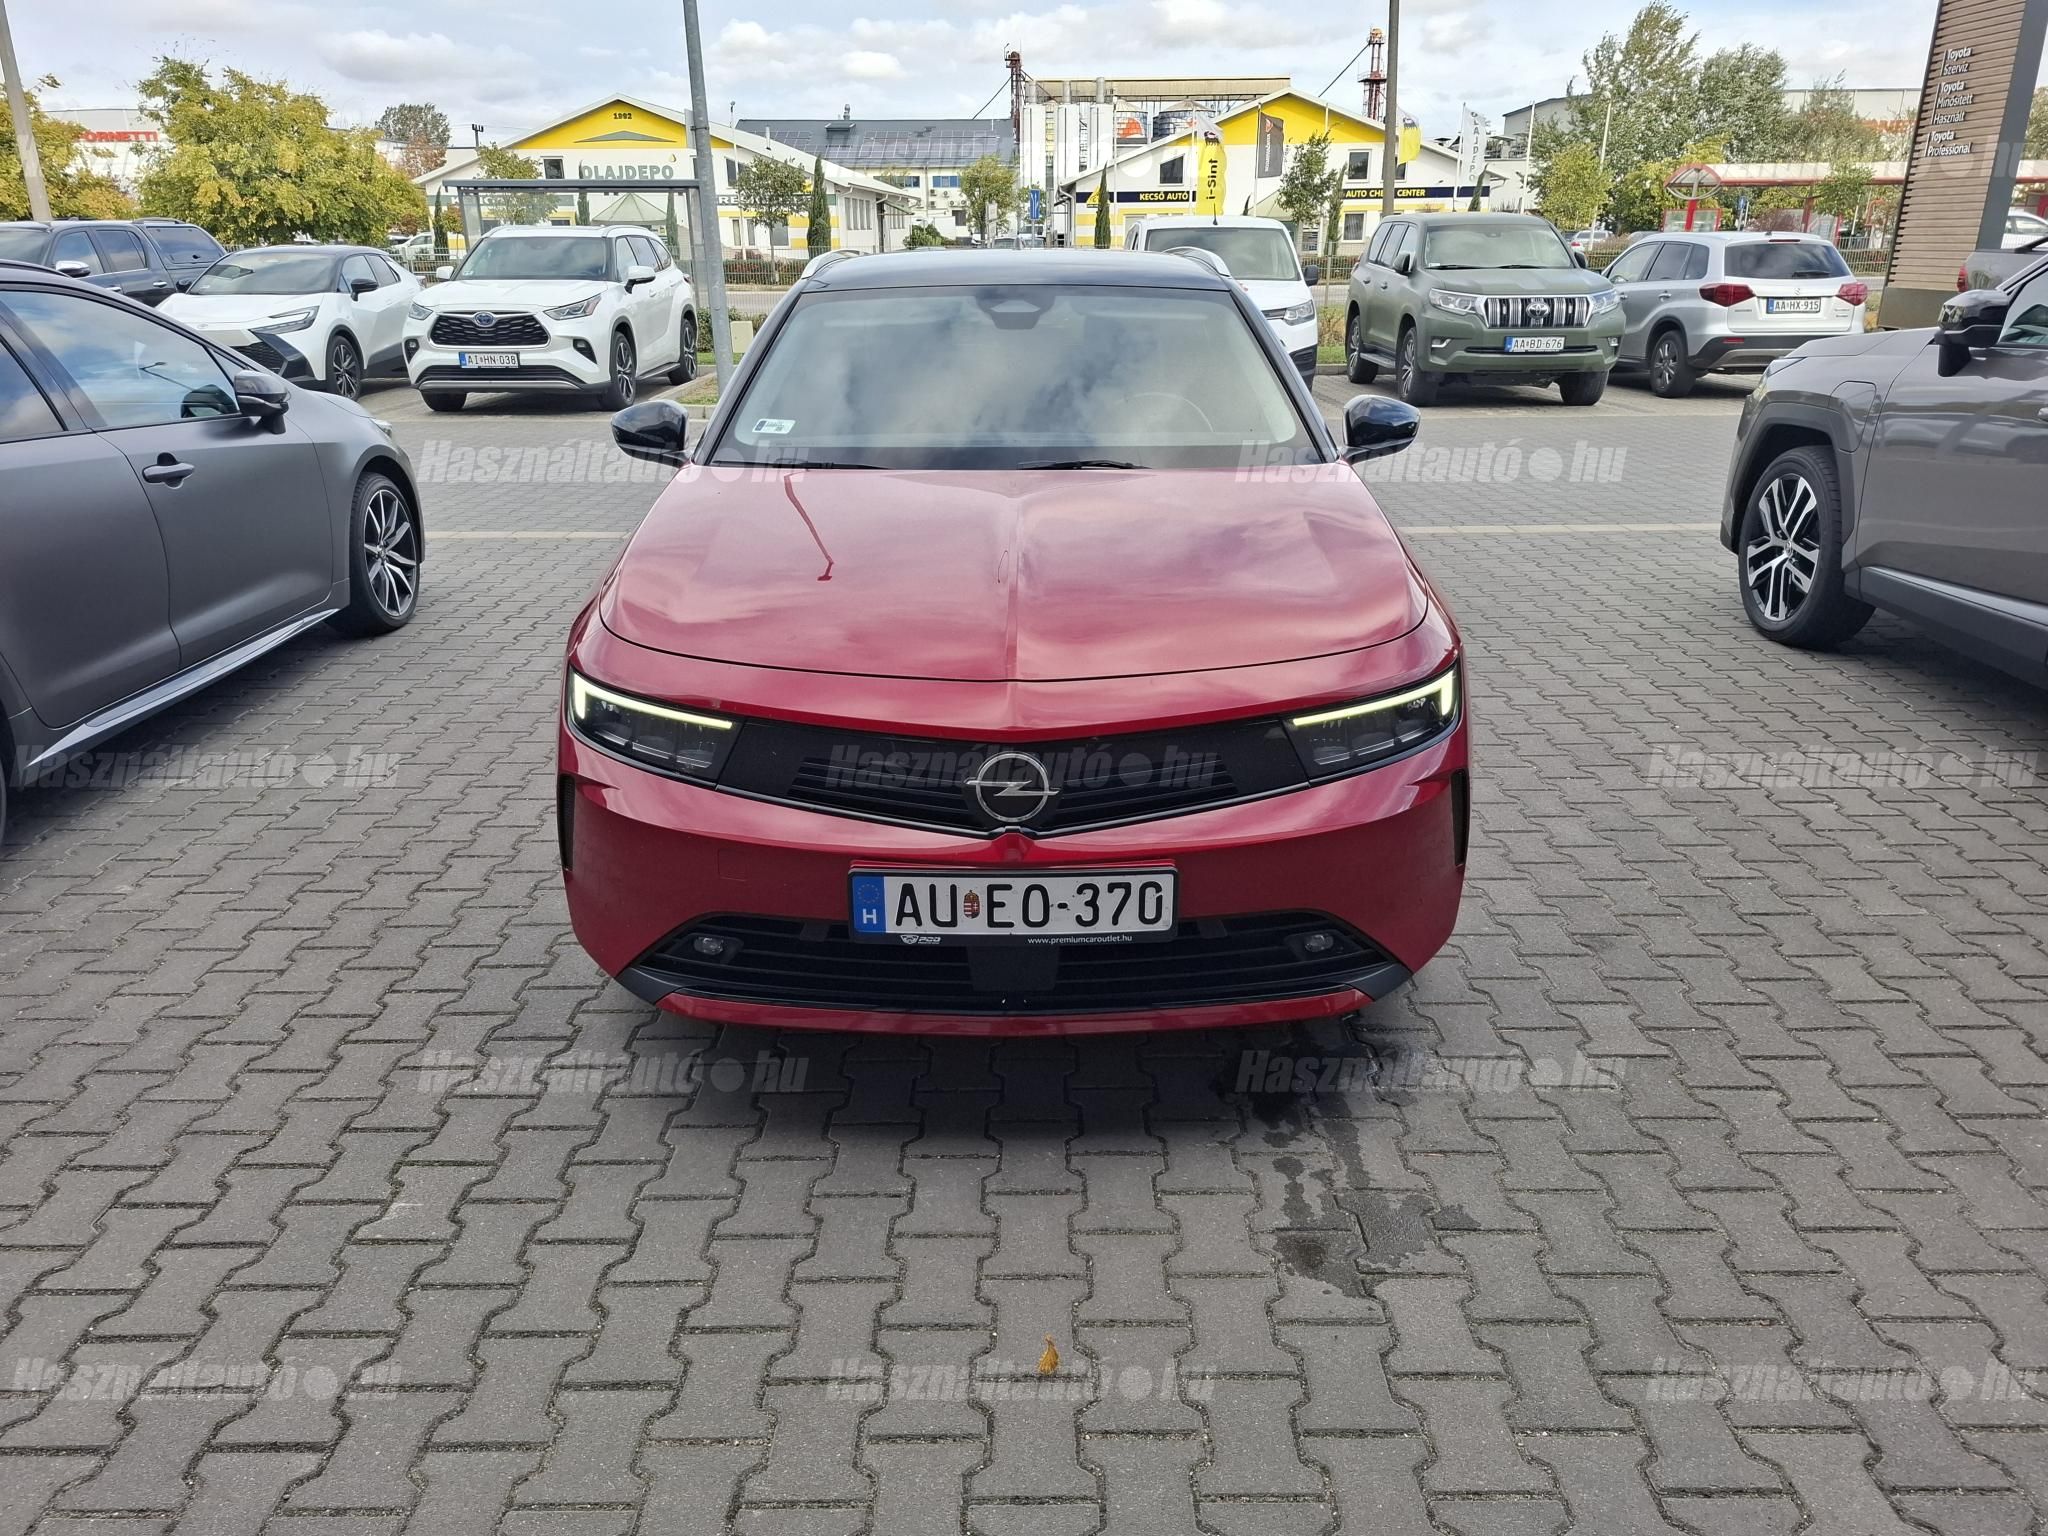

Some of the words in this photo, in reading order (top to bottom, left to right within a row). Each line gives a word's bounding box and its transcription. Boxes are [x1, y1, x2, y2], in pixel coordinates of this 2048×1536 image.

[1947, 47, 1972, 61] Toyota
[1943, 61, 1969, 76] Szerviz
[1940, 81, 1965, 95] Toyota
[1933, 110, 1965, 125] Használt
[1930, 130, 1955, 143] Toyota
[1927, 142, 1971, 157] Professional
[582, 164, 674, 180] OLAJDEPO
[1206, 158, 1218, 200] i-Sint
[1166, 190, 1189, 201] AUTÓ
[1345, 189, 1367, 198] AUTO
[1397, 188, 1425, 197] CENTER
[862, 908, 877, 925] H
[1027, 933, 1133, 945] www.premiumcaroutlet.hu
